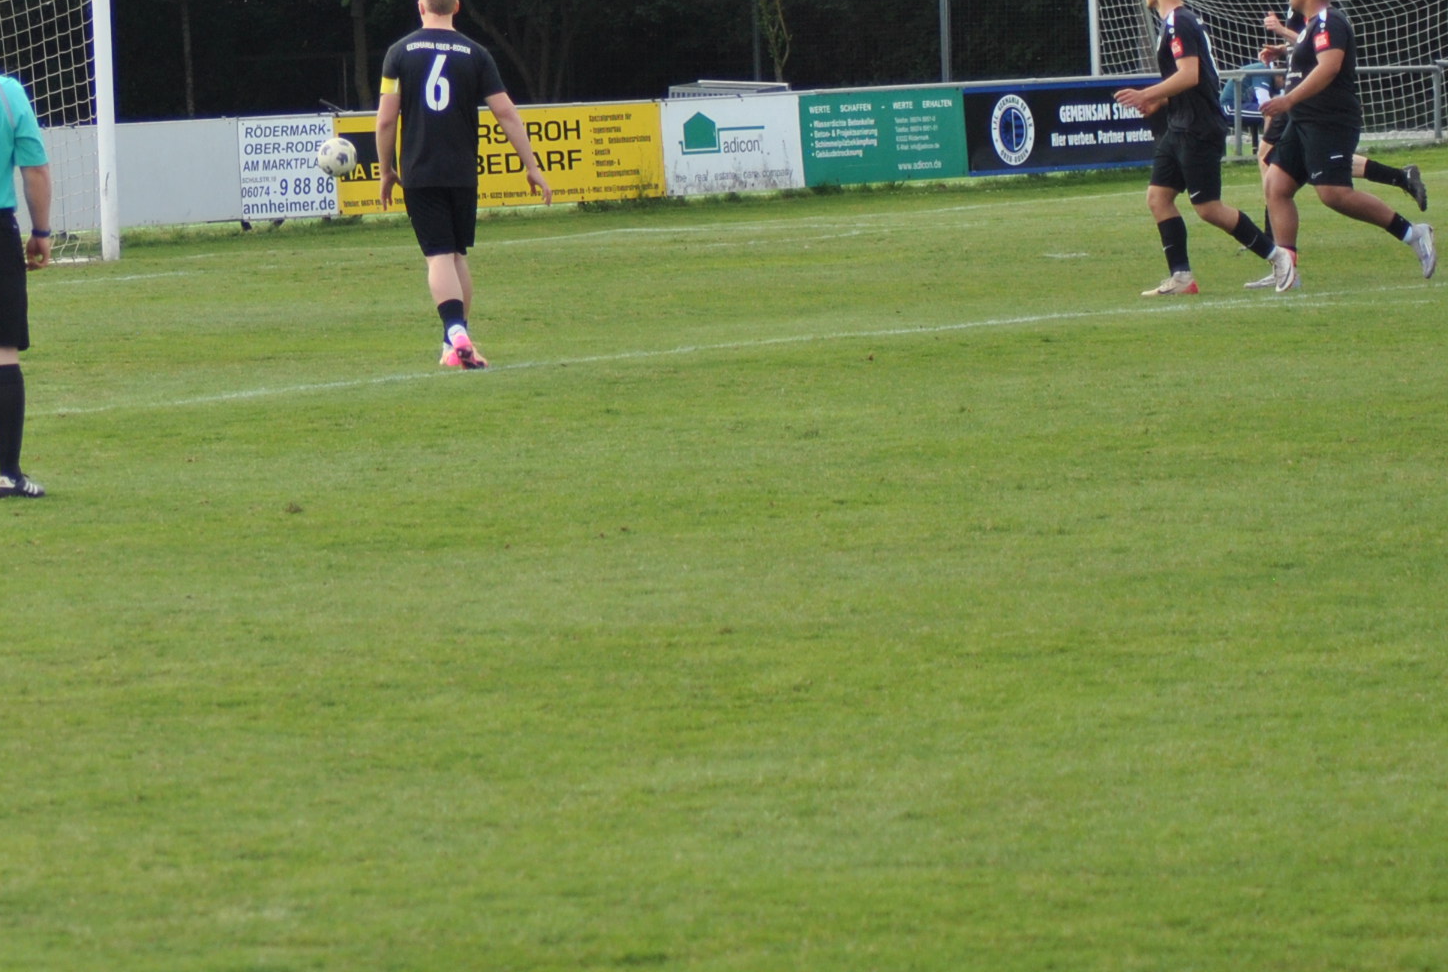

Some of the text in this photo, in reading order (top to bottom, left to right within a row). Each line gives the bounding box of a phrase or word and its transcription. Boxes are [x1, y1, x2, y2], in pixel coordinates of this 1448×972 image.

[425, 54, 450, 112] 6
[808, 105, 831, 114] WERTE
[839, 103, 872, 113] SCHAFFEN
[892, 100, 913, 110] WERTE
[1059, 103, 1111, 123] GEMEINSAM
[244, 123, 331, 139] RÖDERMARK-
[1051, 128, 1155, 147] Hier werben. Partner werden.
[244, 140, 324, 155] OBER-RODE
[723, 137, 760, 154] adicon
[243, 157, 318, 172] AM MARKTPLA
[241, 186, 270, 198] 06074
[280, 178, 288, 196] 9
[293, 177, 311, 195] 88
[316, 176, 334, 194] 86
[243, 196, 336, 215] annheimer.de
